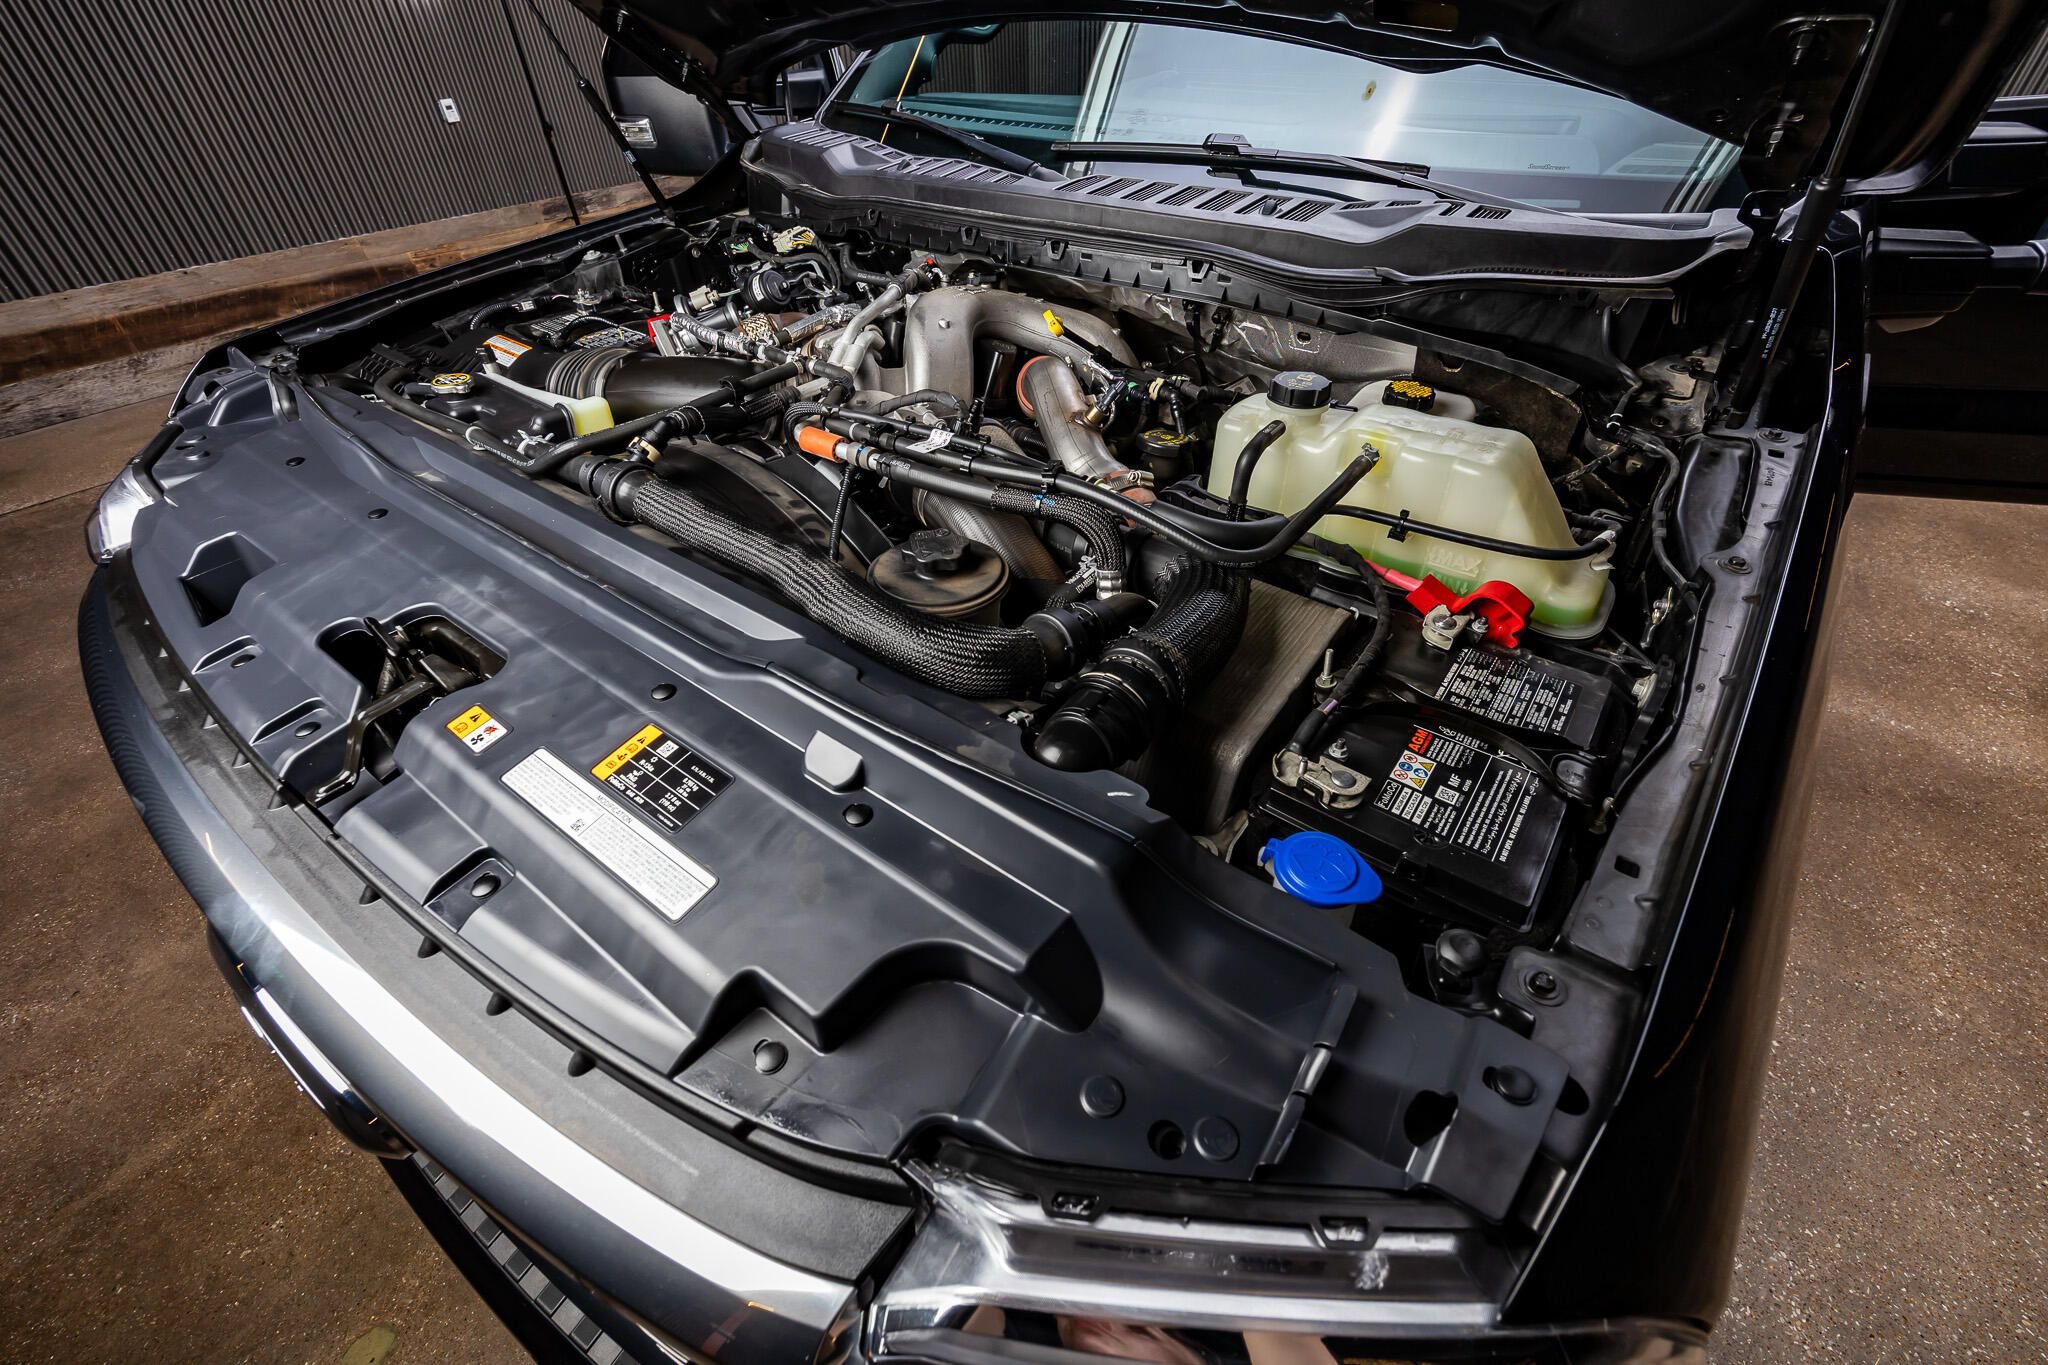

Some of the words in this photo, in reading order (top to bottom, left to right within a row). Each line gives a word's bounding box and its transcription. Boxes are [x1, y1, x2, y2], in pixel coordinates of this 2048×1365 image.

[1408, 728, 1428, 752] AGM
[638, 758, 655, 772] R-134a
[1447, 772, 1462, 788] MF
[1377, 782, 1398, 807] FoMoCo
[596, 794, 633, 824] MODIFICATION
